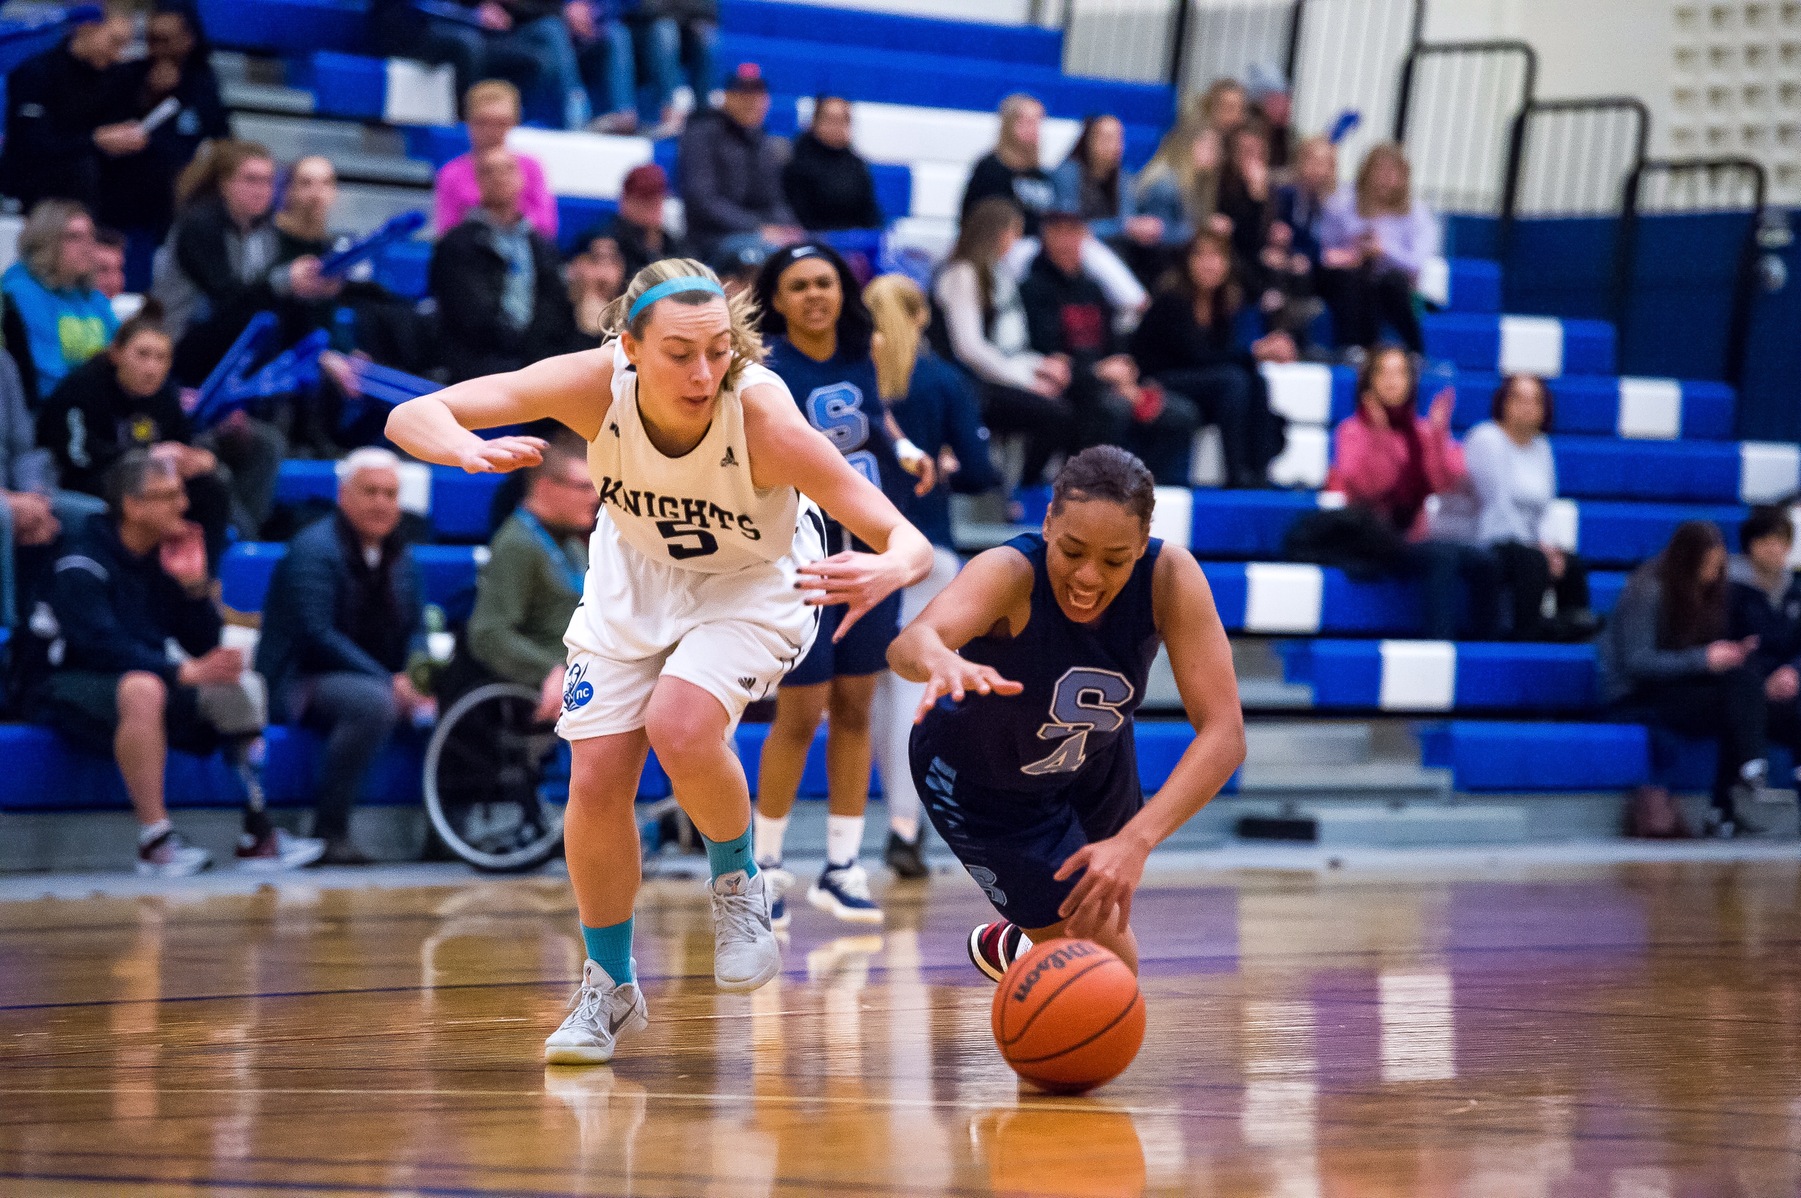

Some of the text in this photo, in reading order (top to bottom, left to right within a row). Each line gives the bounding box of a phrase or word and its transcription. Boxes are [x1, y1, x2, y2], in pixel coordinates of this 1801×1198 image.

[805, 380, 870, 455] S
[599, 476, 761, 541] KNIGHTS
[656, 520, 719, 560] 5
[576, 688, 590, 699] nc
